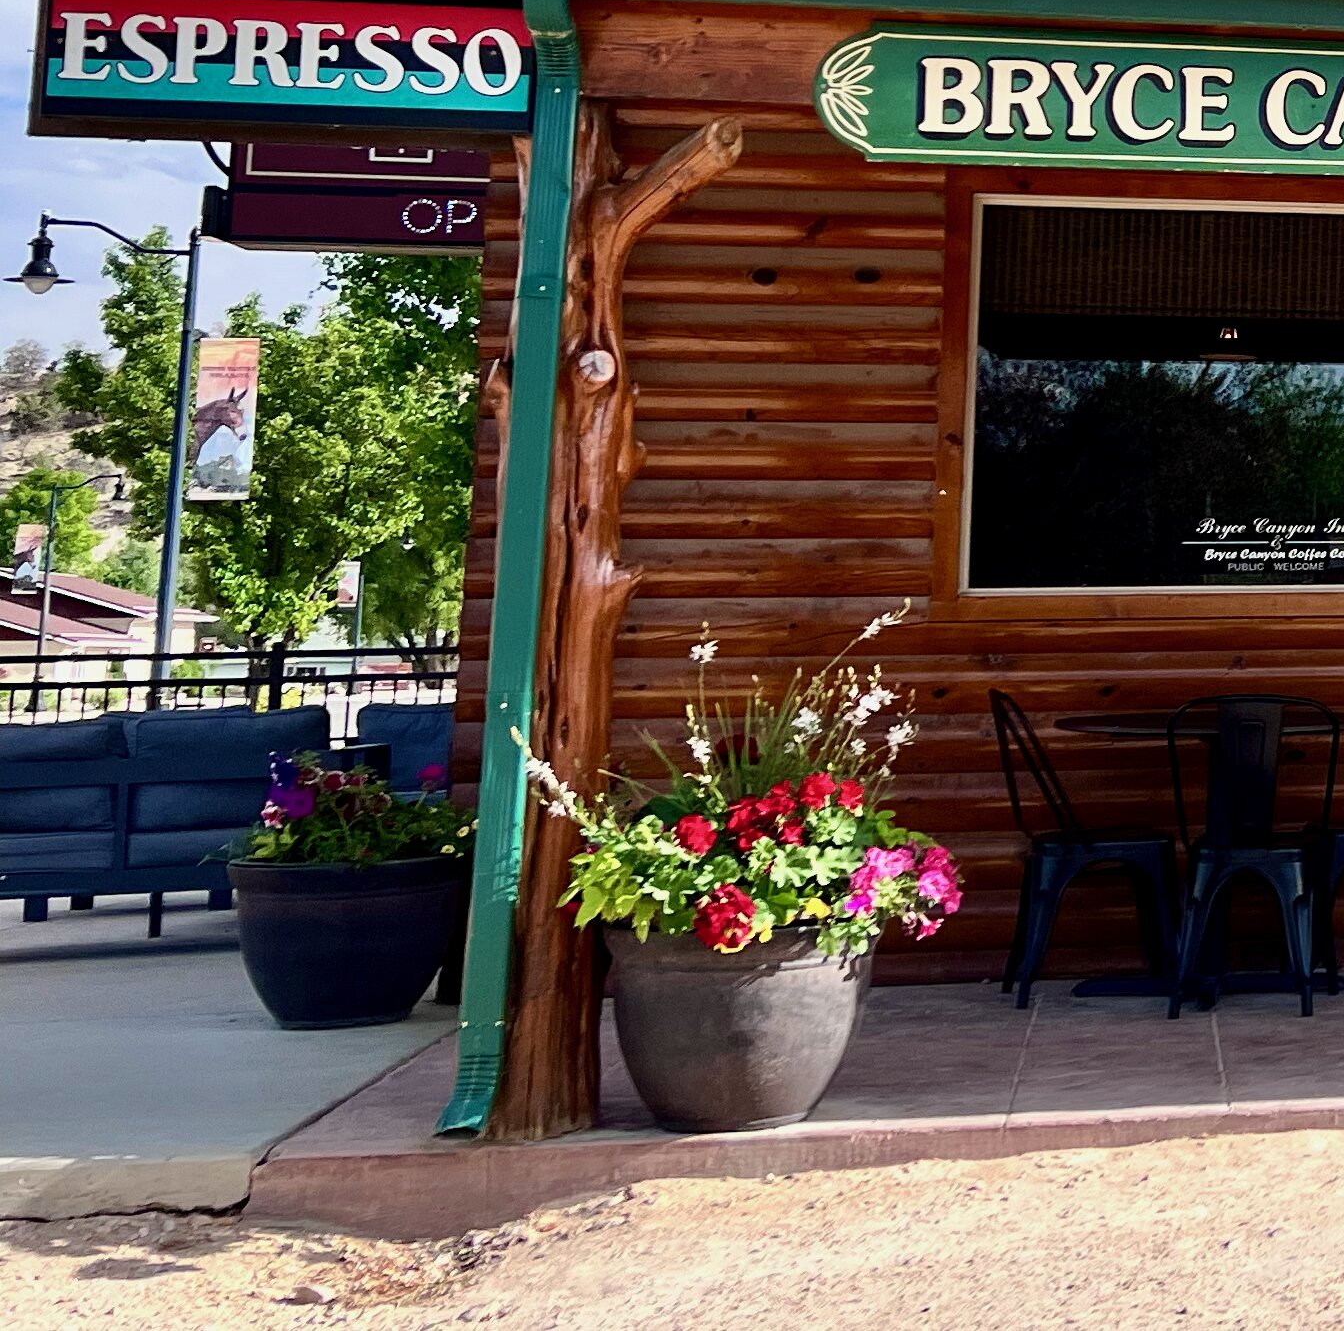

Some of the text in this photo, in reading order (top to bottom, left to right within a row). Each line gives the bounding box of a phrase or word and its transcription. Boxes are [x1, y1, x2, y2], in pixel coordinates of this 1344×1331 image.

[57, 12, 522, 96] ESPRESSO
[918, 56, 1236, 147] BRYCE
[1195, 517, 1247, 540] Bryce
[1252, 517, 1316, 540] Canyon
[1270, 535, 1284, 550] &
[1203, 548, 1238, 562] Bryce
[1239, 550, 1286, 562] Canyon
[1288, 548, 1327, 562] Coffee
[1227, 562, 1325, 571] PUBLIC WELCOME
